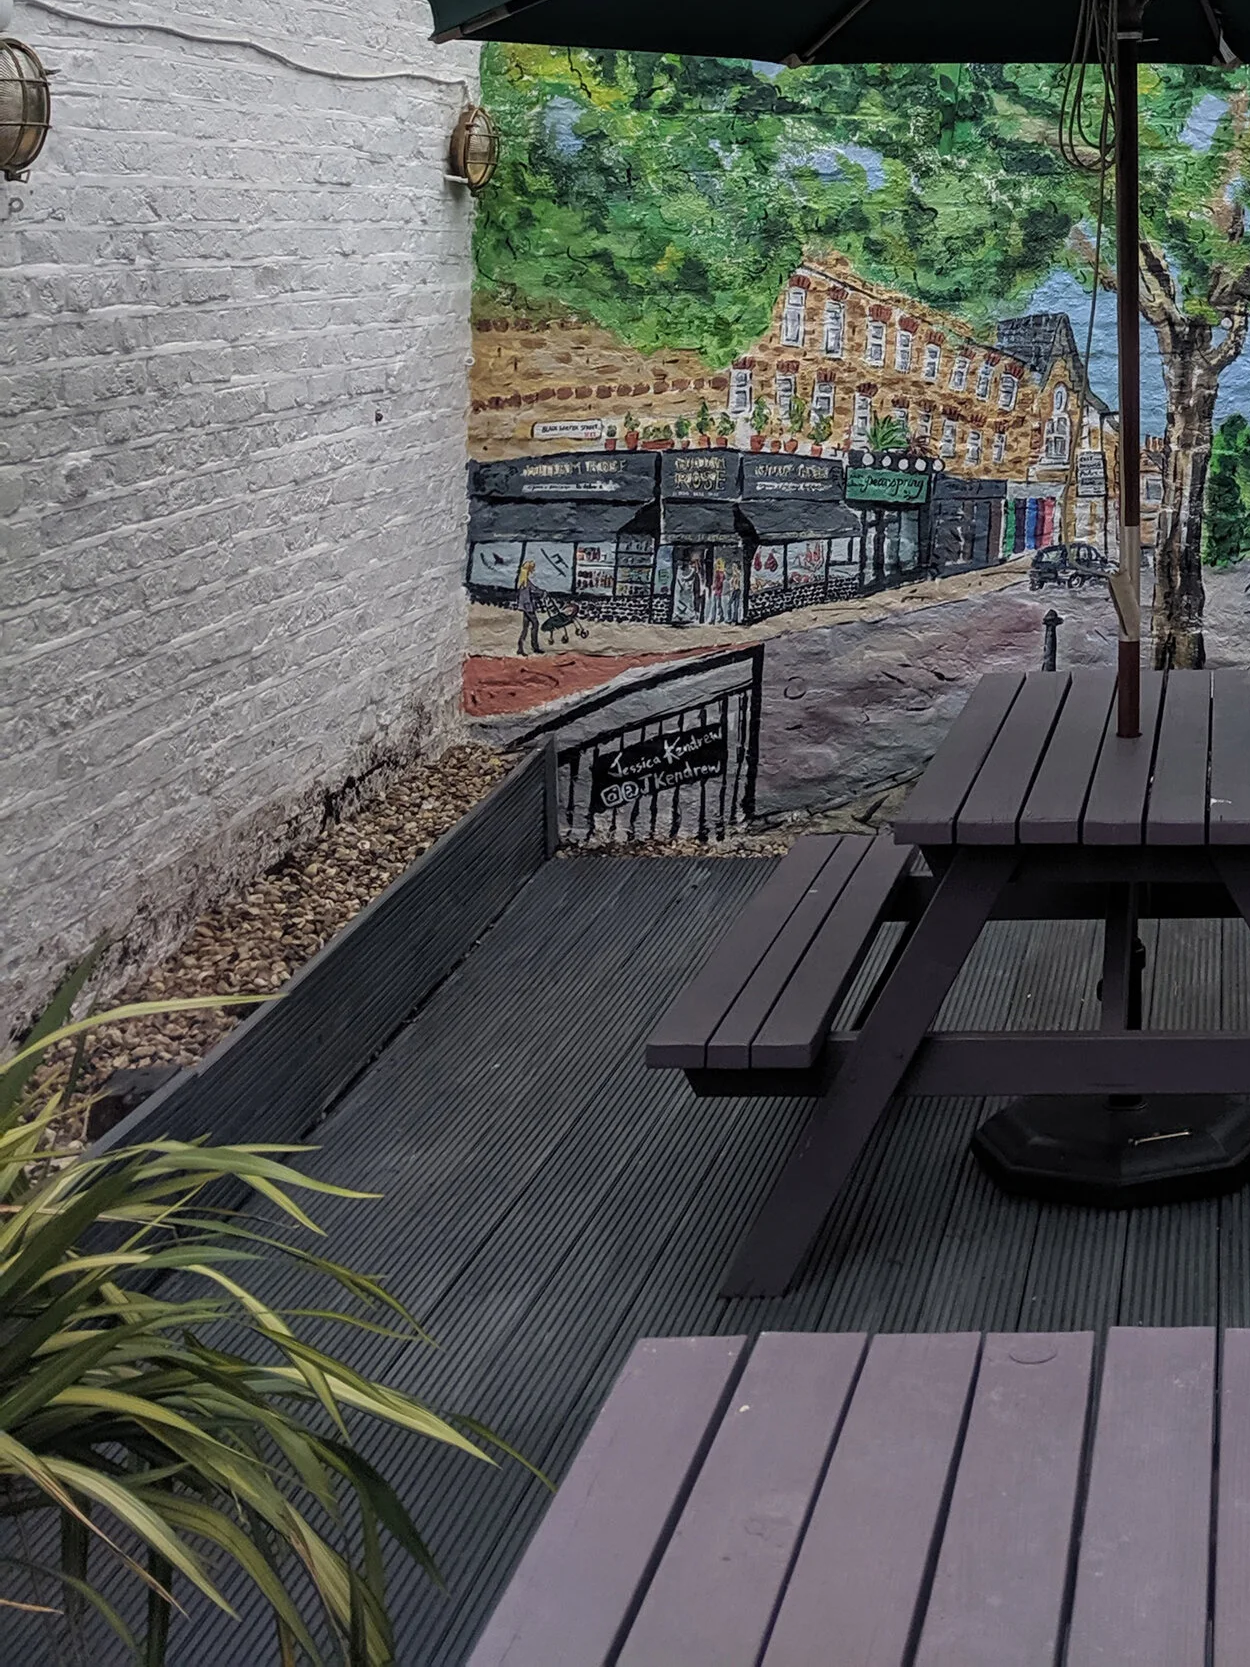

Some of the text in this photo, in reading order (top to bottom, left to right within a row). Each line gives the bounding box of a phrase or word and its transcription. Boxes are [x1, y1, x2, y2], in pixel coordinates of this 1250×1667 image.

[674, 470, 726, 490] ROSE
[608, 727, 722, 778] Jessica Kendrew
